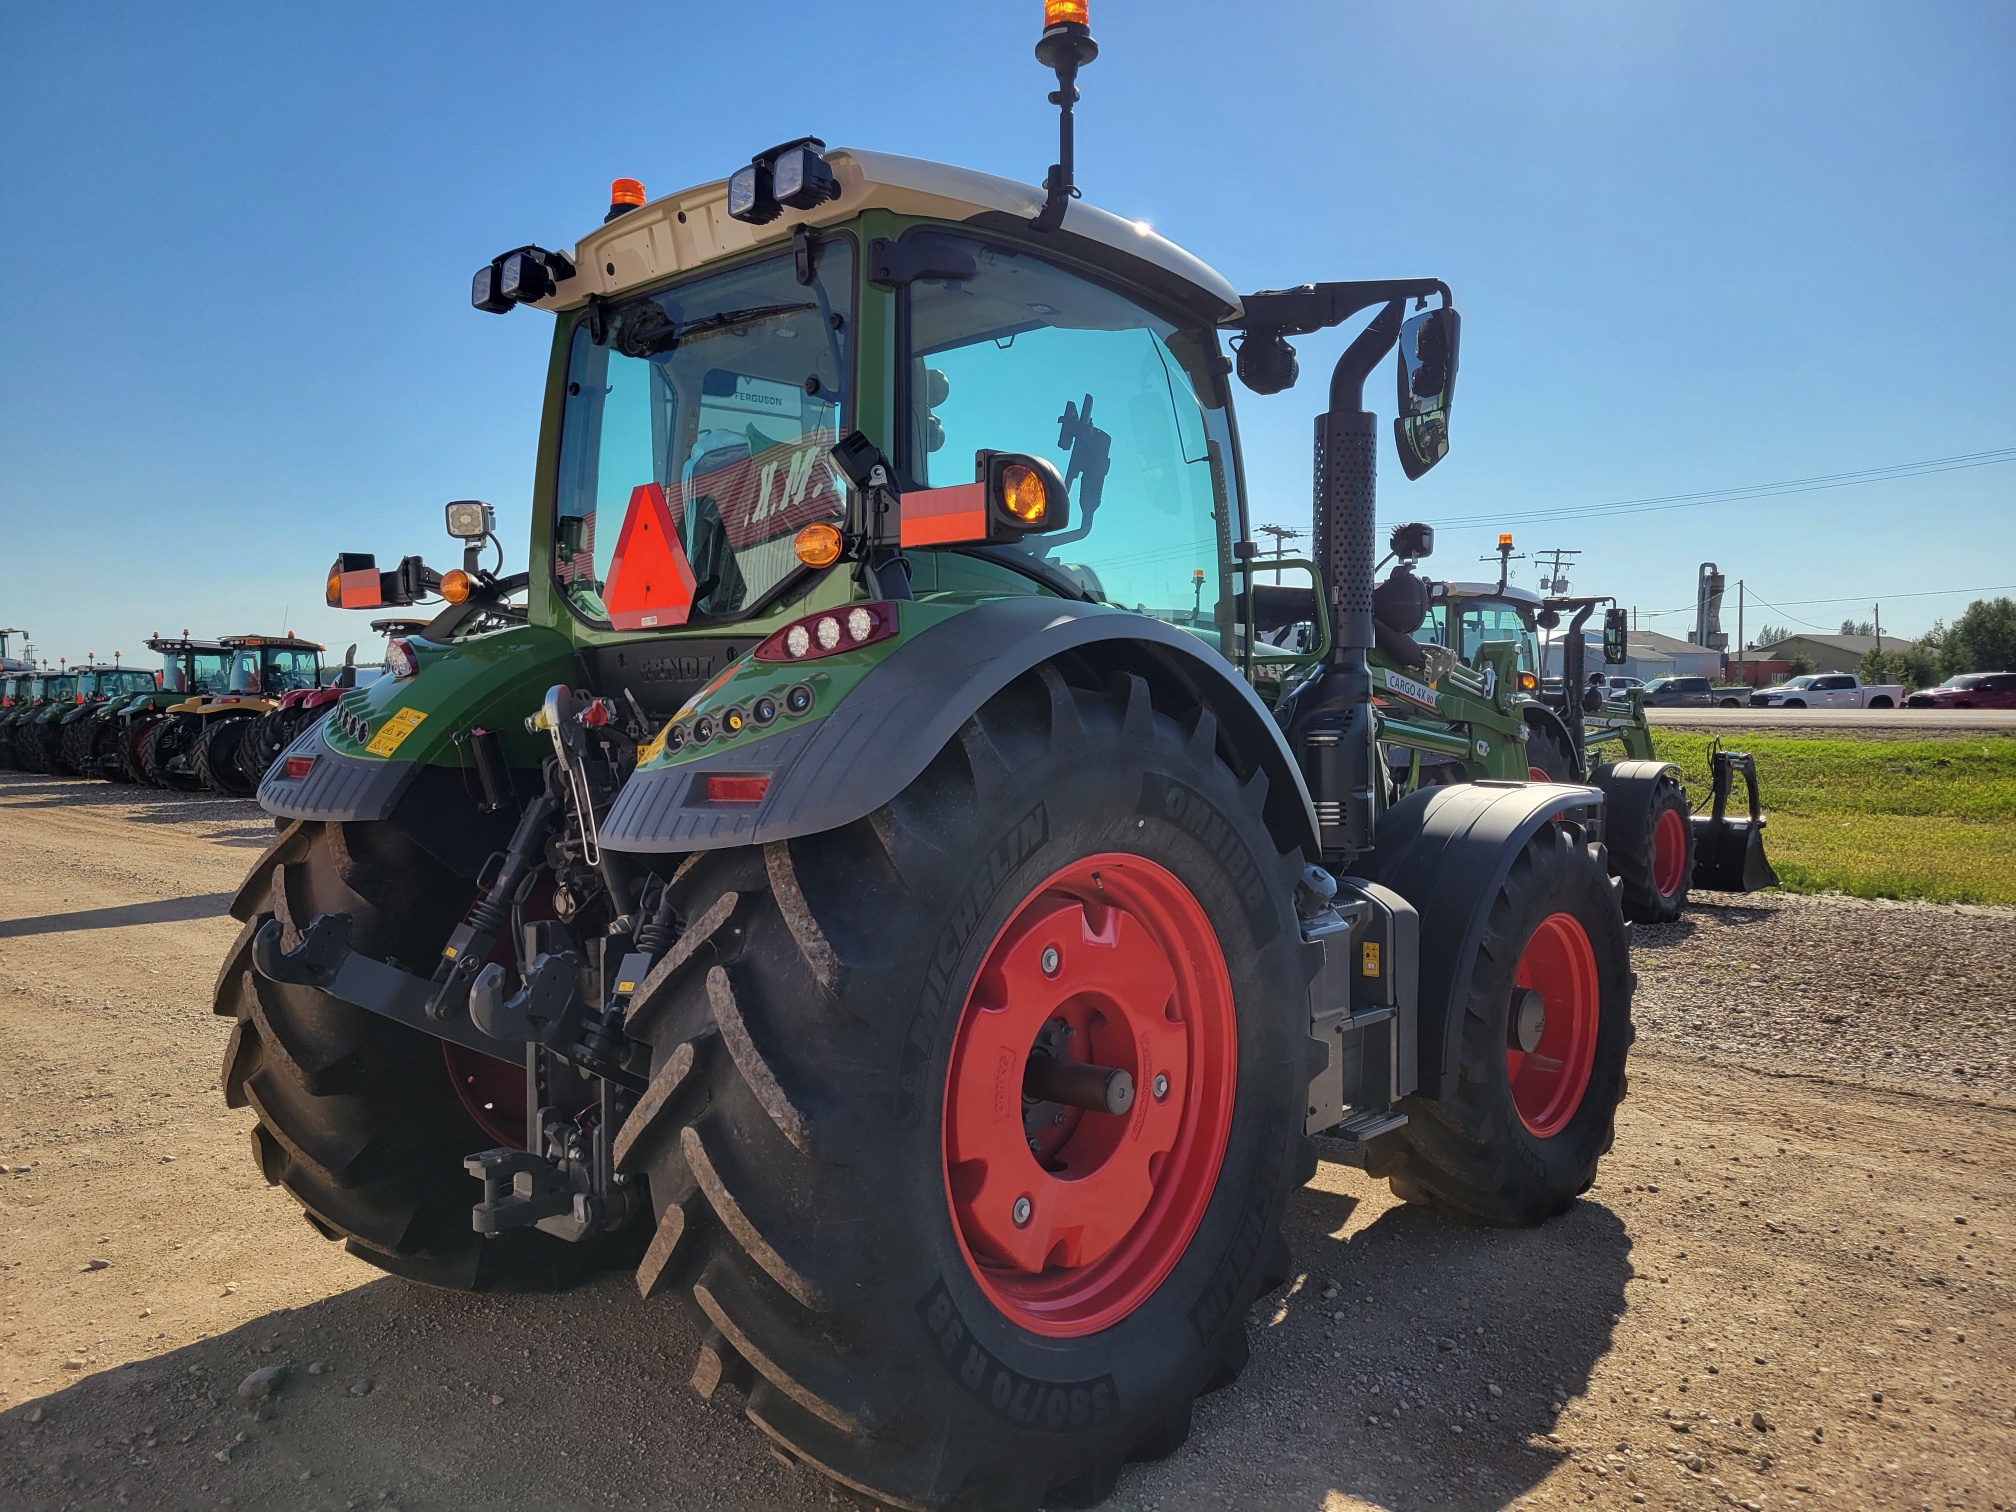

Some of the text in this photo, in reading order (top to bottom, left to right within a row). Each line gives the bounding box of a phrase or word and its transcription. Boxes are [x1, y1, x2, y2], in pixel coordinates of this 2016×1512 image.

[734, 391, 783, 406] FERGUSON
[640, 655, 715, 682] FENDT
[1389, 674, 1416, 697] CARGO
[1166, 787, 1265, 911] OMNIBIB
[908, 803, 1045, 1054] MICHELIN
[927, 1292, 1111, 1427] 580/70 R 38
